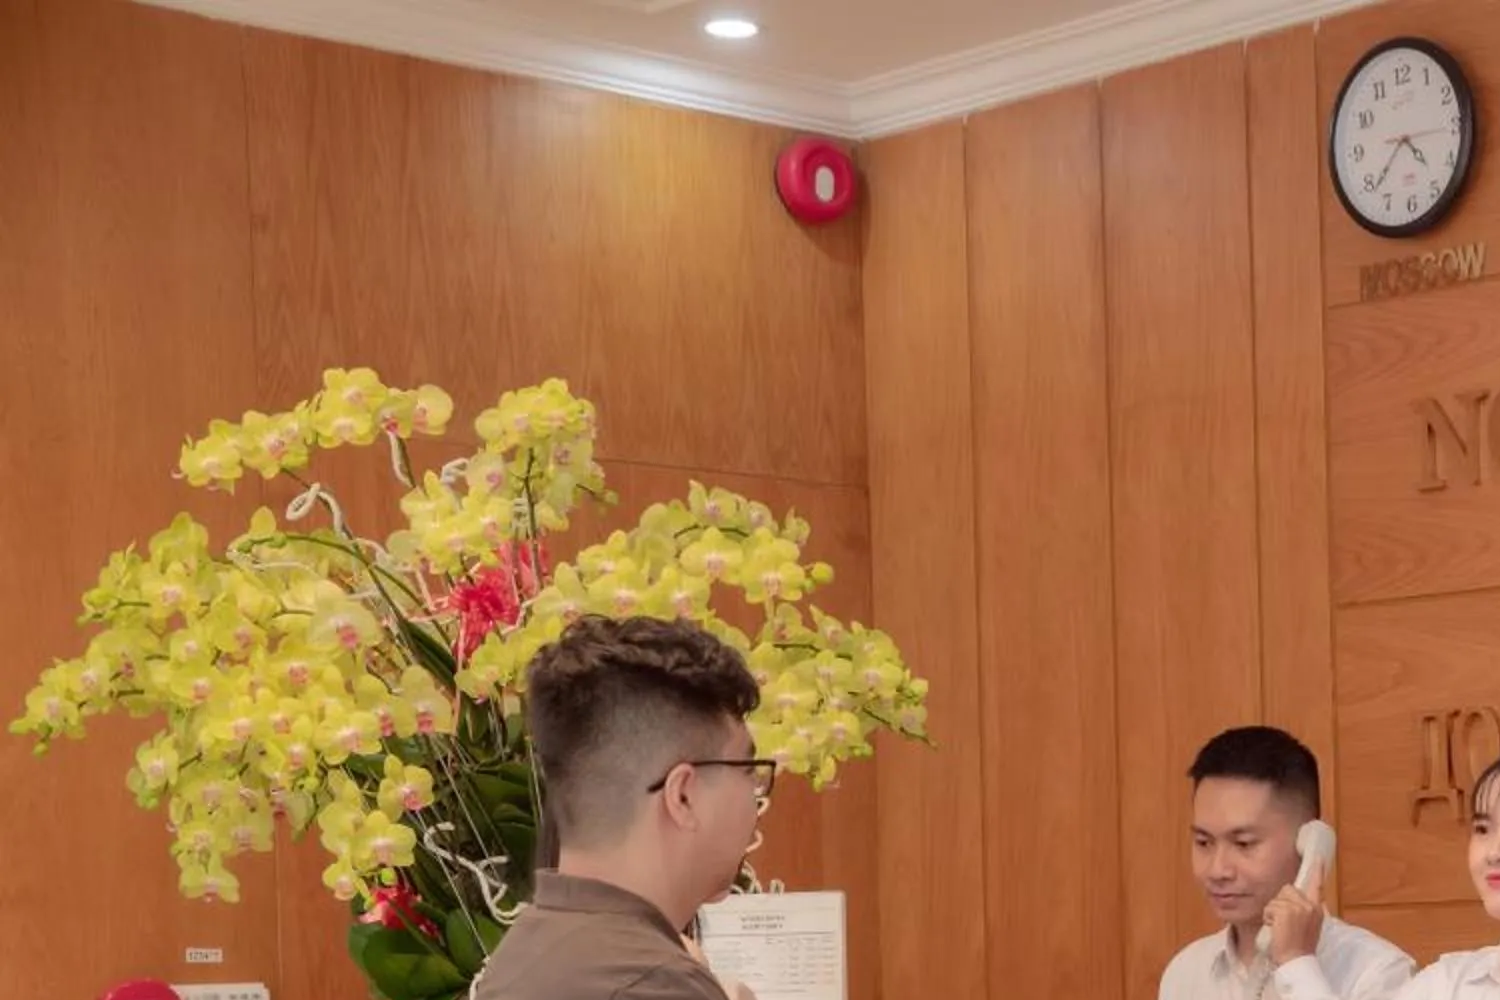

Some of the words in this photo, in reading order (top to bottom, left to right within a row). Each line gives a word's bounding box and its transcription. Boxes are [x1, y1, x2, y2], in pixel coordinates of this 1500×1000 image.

[1394, 64, 1411, 85] 12
[1423, 67, 1430, 86] 1
[1373, 81, 1387, 101] 11
[1441, 85, 1453, 106] 2
[1358, 110, 1374, 129] 10
[1353, 144, 1364, 163] 9
[1363, 174, 1375, 192] 8
[1430, 181, 1441, 199] 5
[1383, 194, 1392, 212] 7
[1407, 195, 1417, 213] 6
[1359, 243, 1486, 302] MOSCOW
